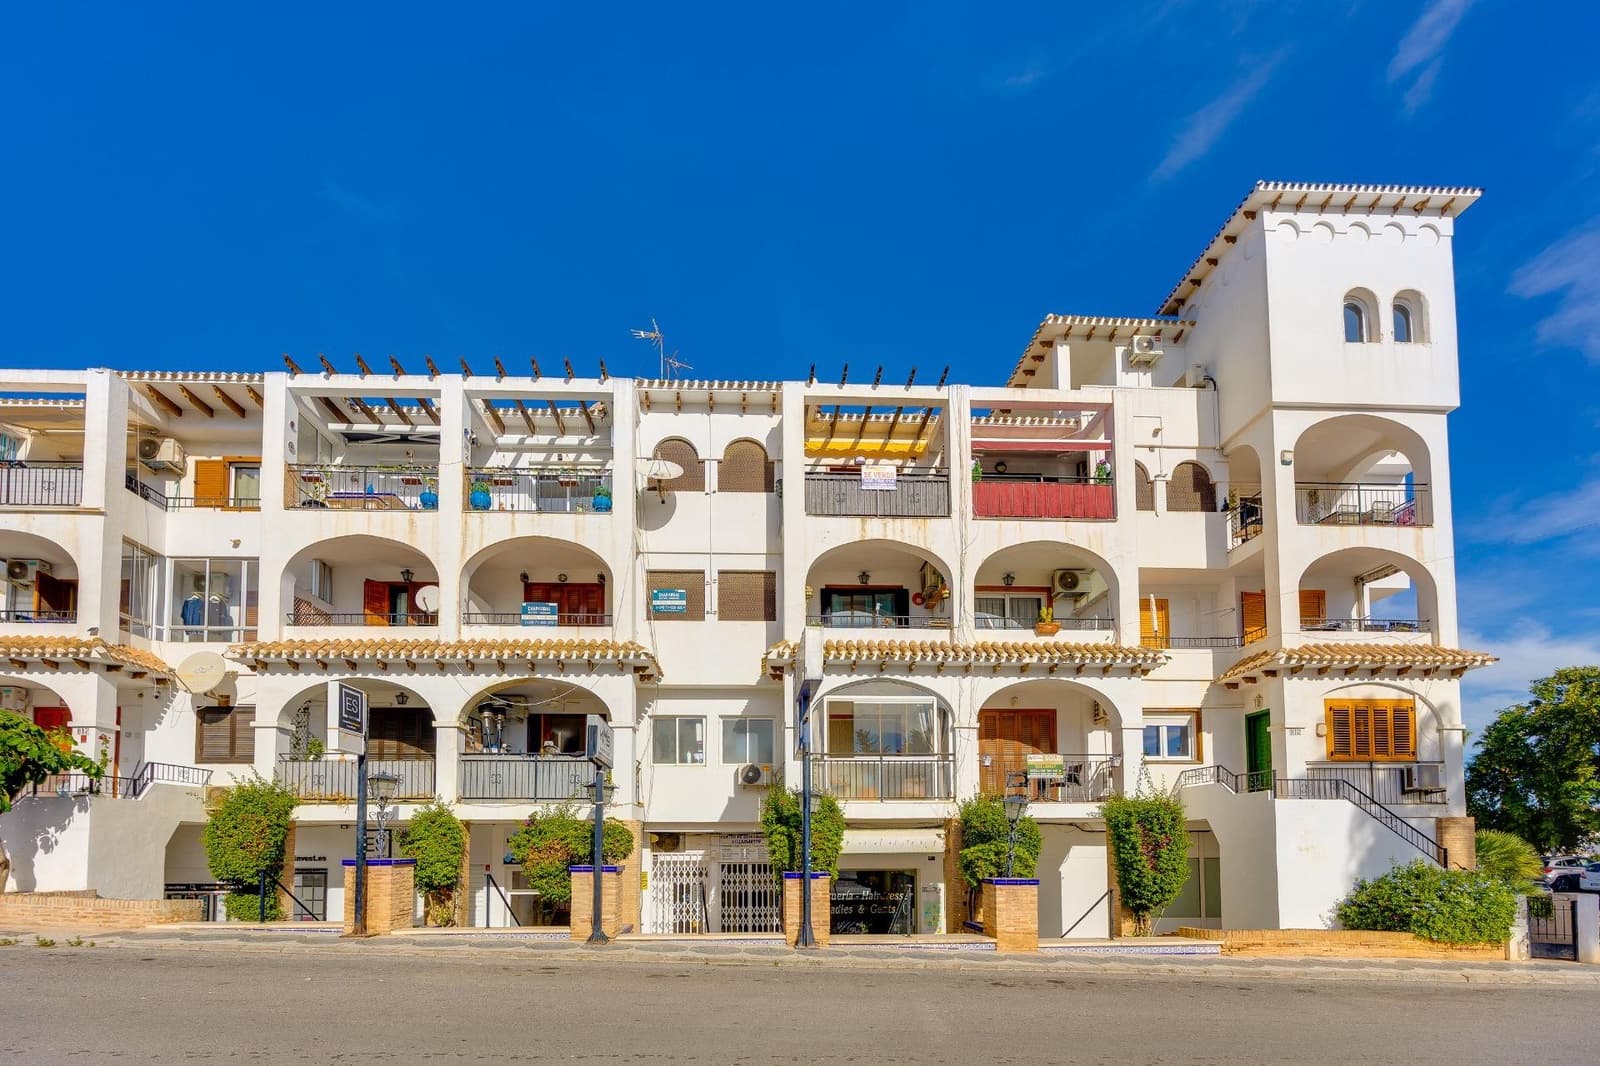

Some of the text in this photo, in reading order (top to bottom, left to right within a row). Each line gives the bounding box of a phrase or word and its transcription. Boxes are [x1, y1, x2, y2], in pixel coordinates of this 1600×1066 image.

[345, 696, 359, 714] ES
[829, 890, 854, 900] uería
[831, 904, 854, 914] adies
[857, 904, 865, 914] &
